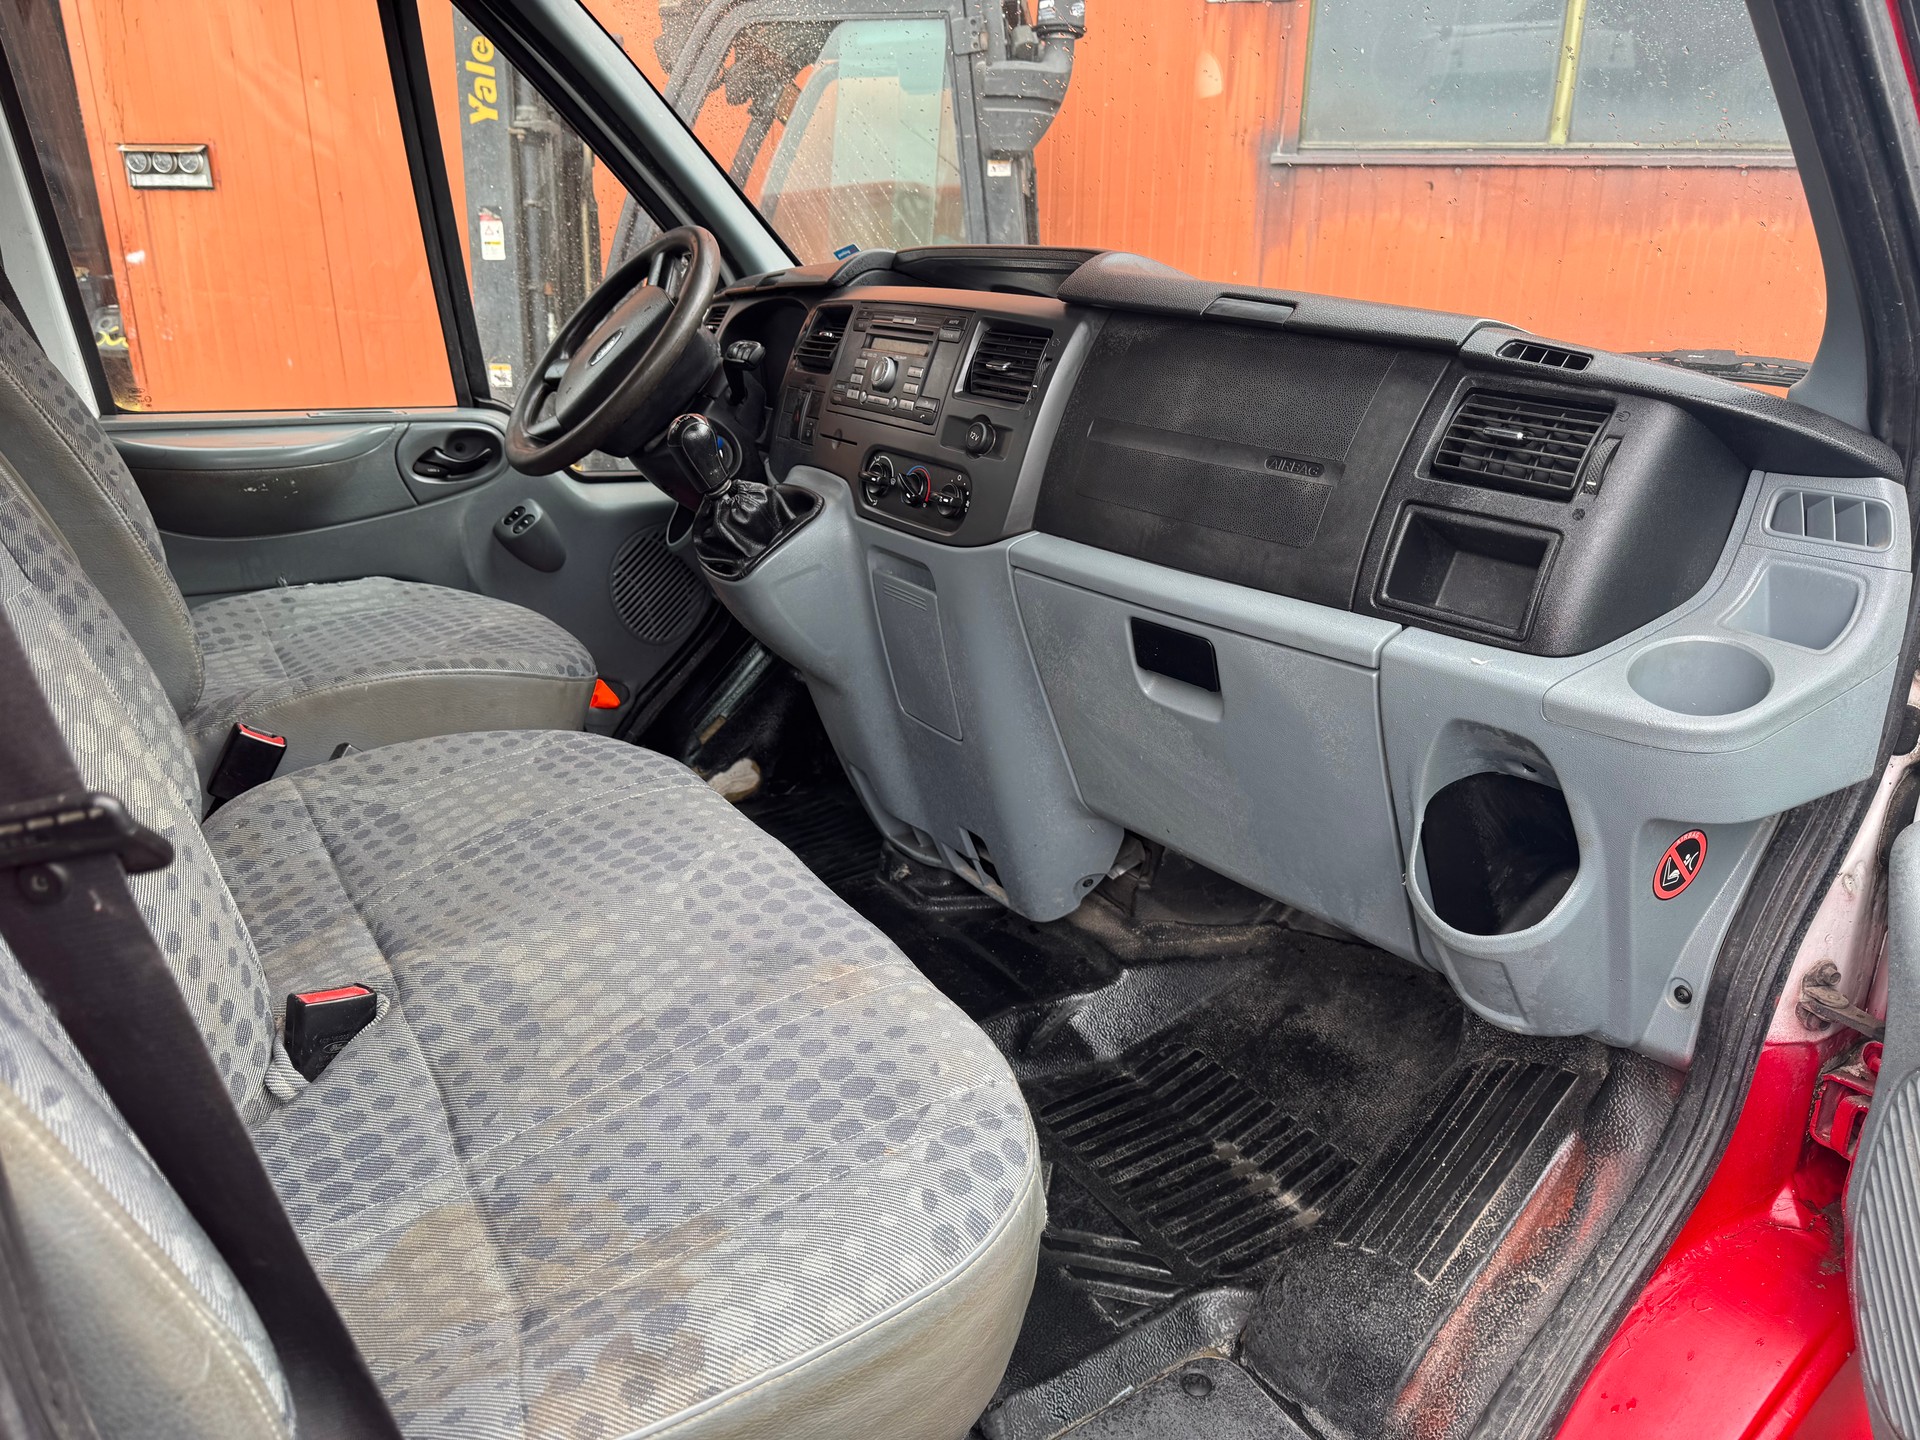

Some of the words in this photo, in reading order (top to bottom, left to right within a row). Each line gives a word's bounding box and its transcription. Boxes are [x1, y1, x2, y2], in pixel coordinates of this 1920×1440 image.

[465, 35, 499, 125] Yale
[969, 431, 979, 442] 12V
[1268, 459, 1319, 476] AIRBAG
